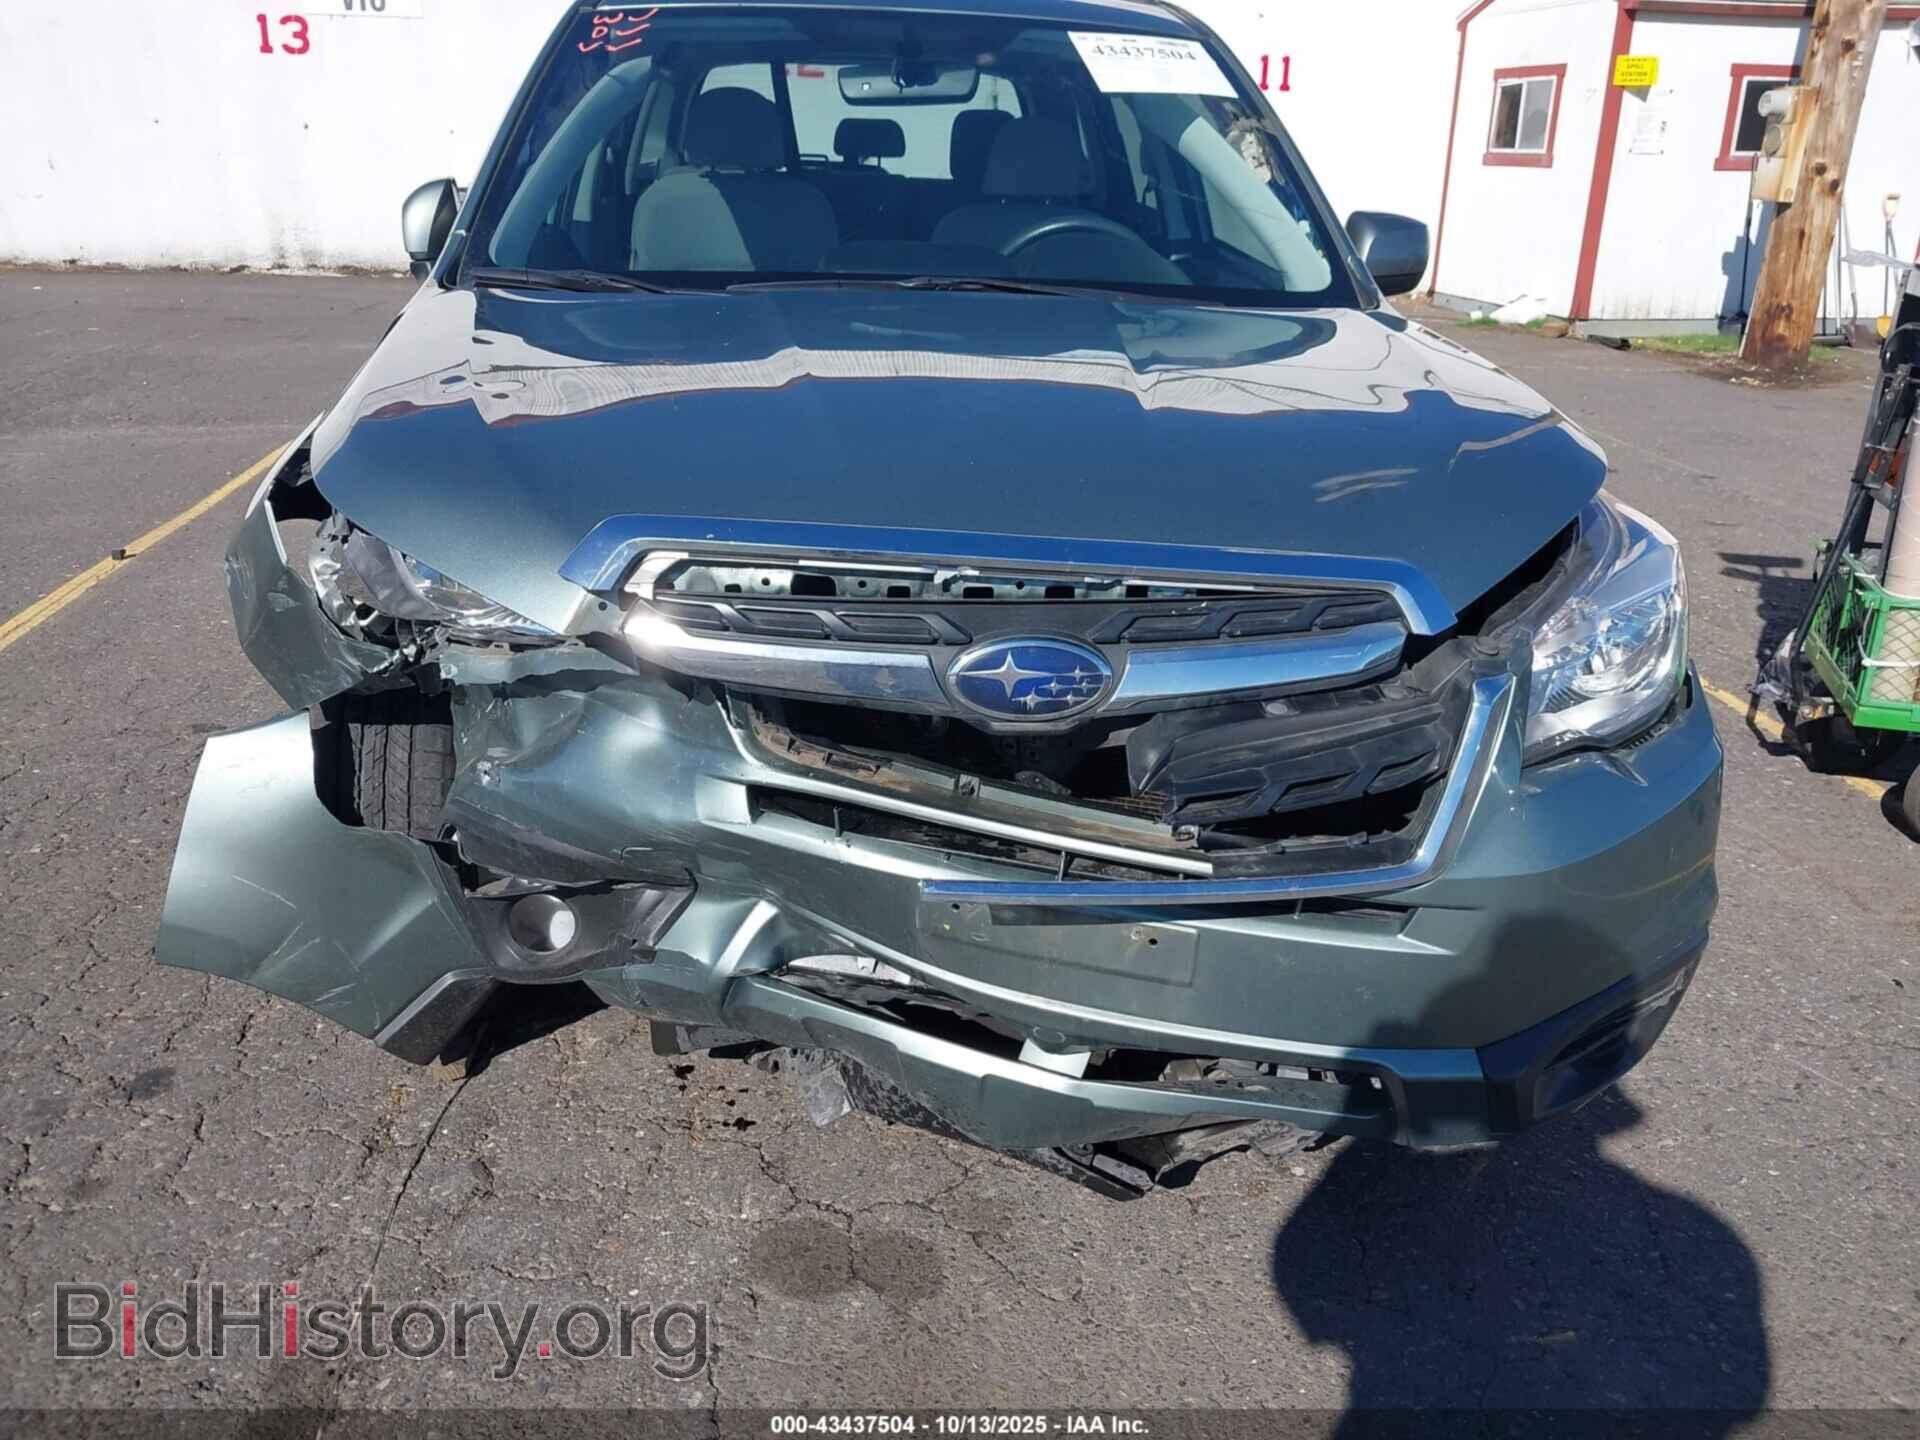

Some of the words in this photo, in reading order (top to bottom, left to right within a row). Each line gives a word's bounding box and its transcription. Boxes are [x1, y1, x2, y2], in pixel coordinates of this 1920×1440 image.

[256, 14, 310, 54] 13
[1092, 44, 1197, 61] 43437504
[1258, 54, 1291, 91] 11
